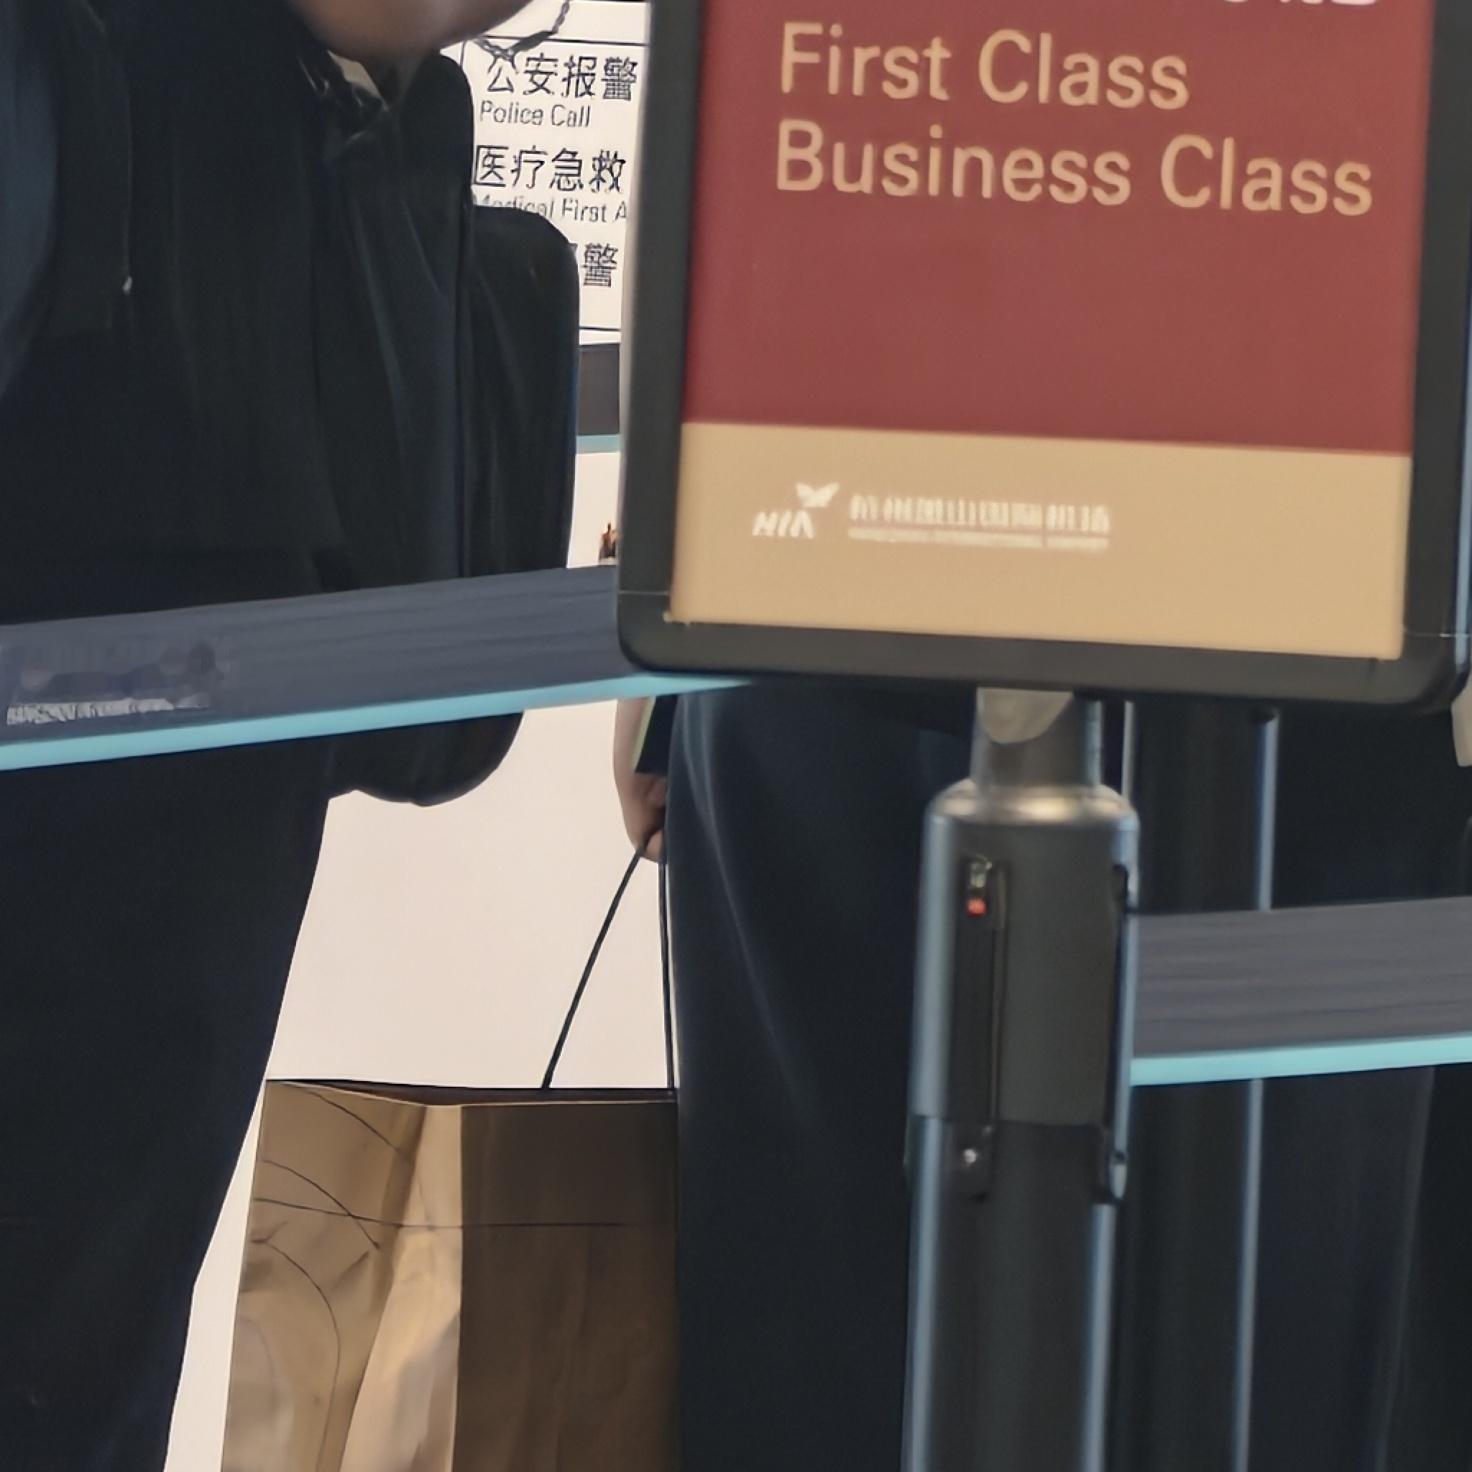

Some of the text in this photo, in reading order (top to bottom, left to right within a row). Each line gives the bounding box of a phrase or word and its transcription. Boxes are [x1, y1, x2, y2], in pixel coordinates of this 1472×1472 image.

[487, 53, 638, 101] 公安报警
[780, 22, 1190, 112] First Class
[480, 100, 591, 127] Police Call
[474, 145, 626, 193] 医疗急救
[775, 119, 1373, 216] Business Class
[562, 198, 607, 223] First
